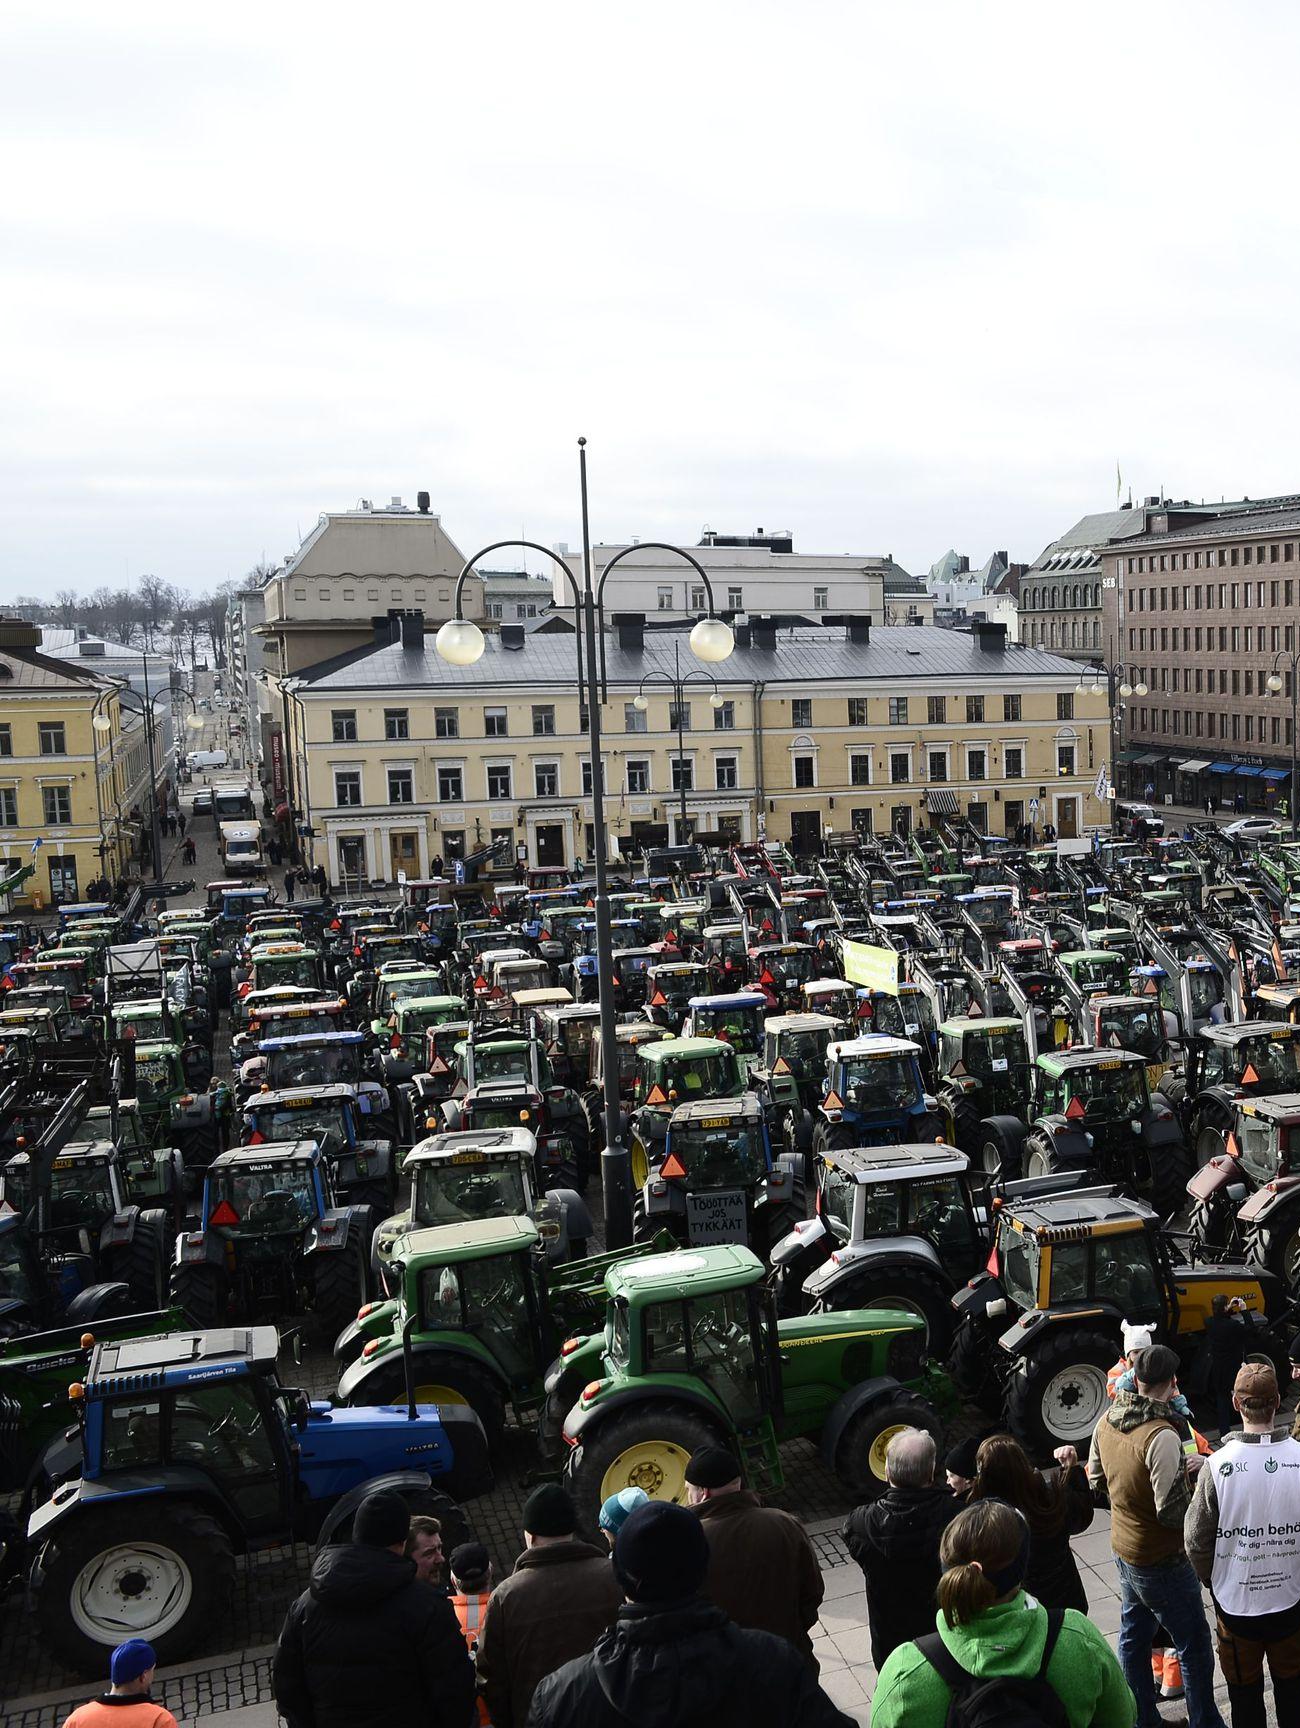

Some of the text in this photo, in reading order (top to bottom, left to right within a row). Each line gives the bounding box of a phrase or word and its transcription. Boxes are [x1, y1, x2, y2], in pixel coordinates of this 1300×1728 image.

[1102, 577, 1116, 588] SEB
[455, 863, 460, 875] P
[708, 1209, 727, 1219] JOS
[691, 1217, 743, 1232] TYKKÄÄT
[27, 1357, 76, 1372] Quicke
[1236, 1462, 1249, 1472] SLC
[1216, 1526, 1264, 1539] Bonden
[1284, 1538, 1295, 1546] dig
